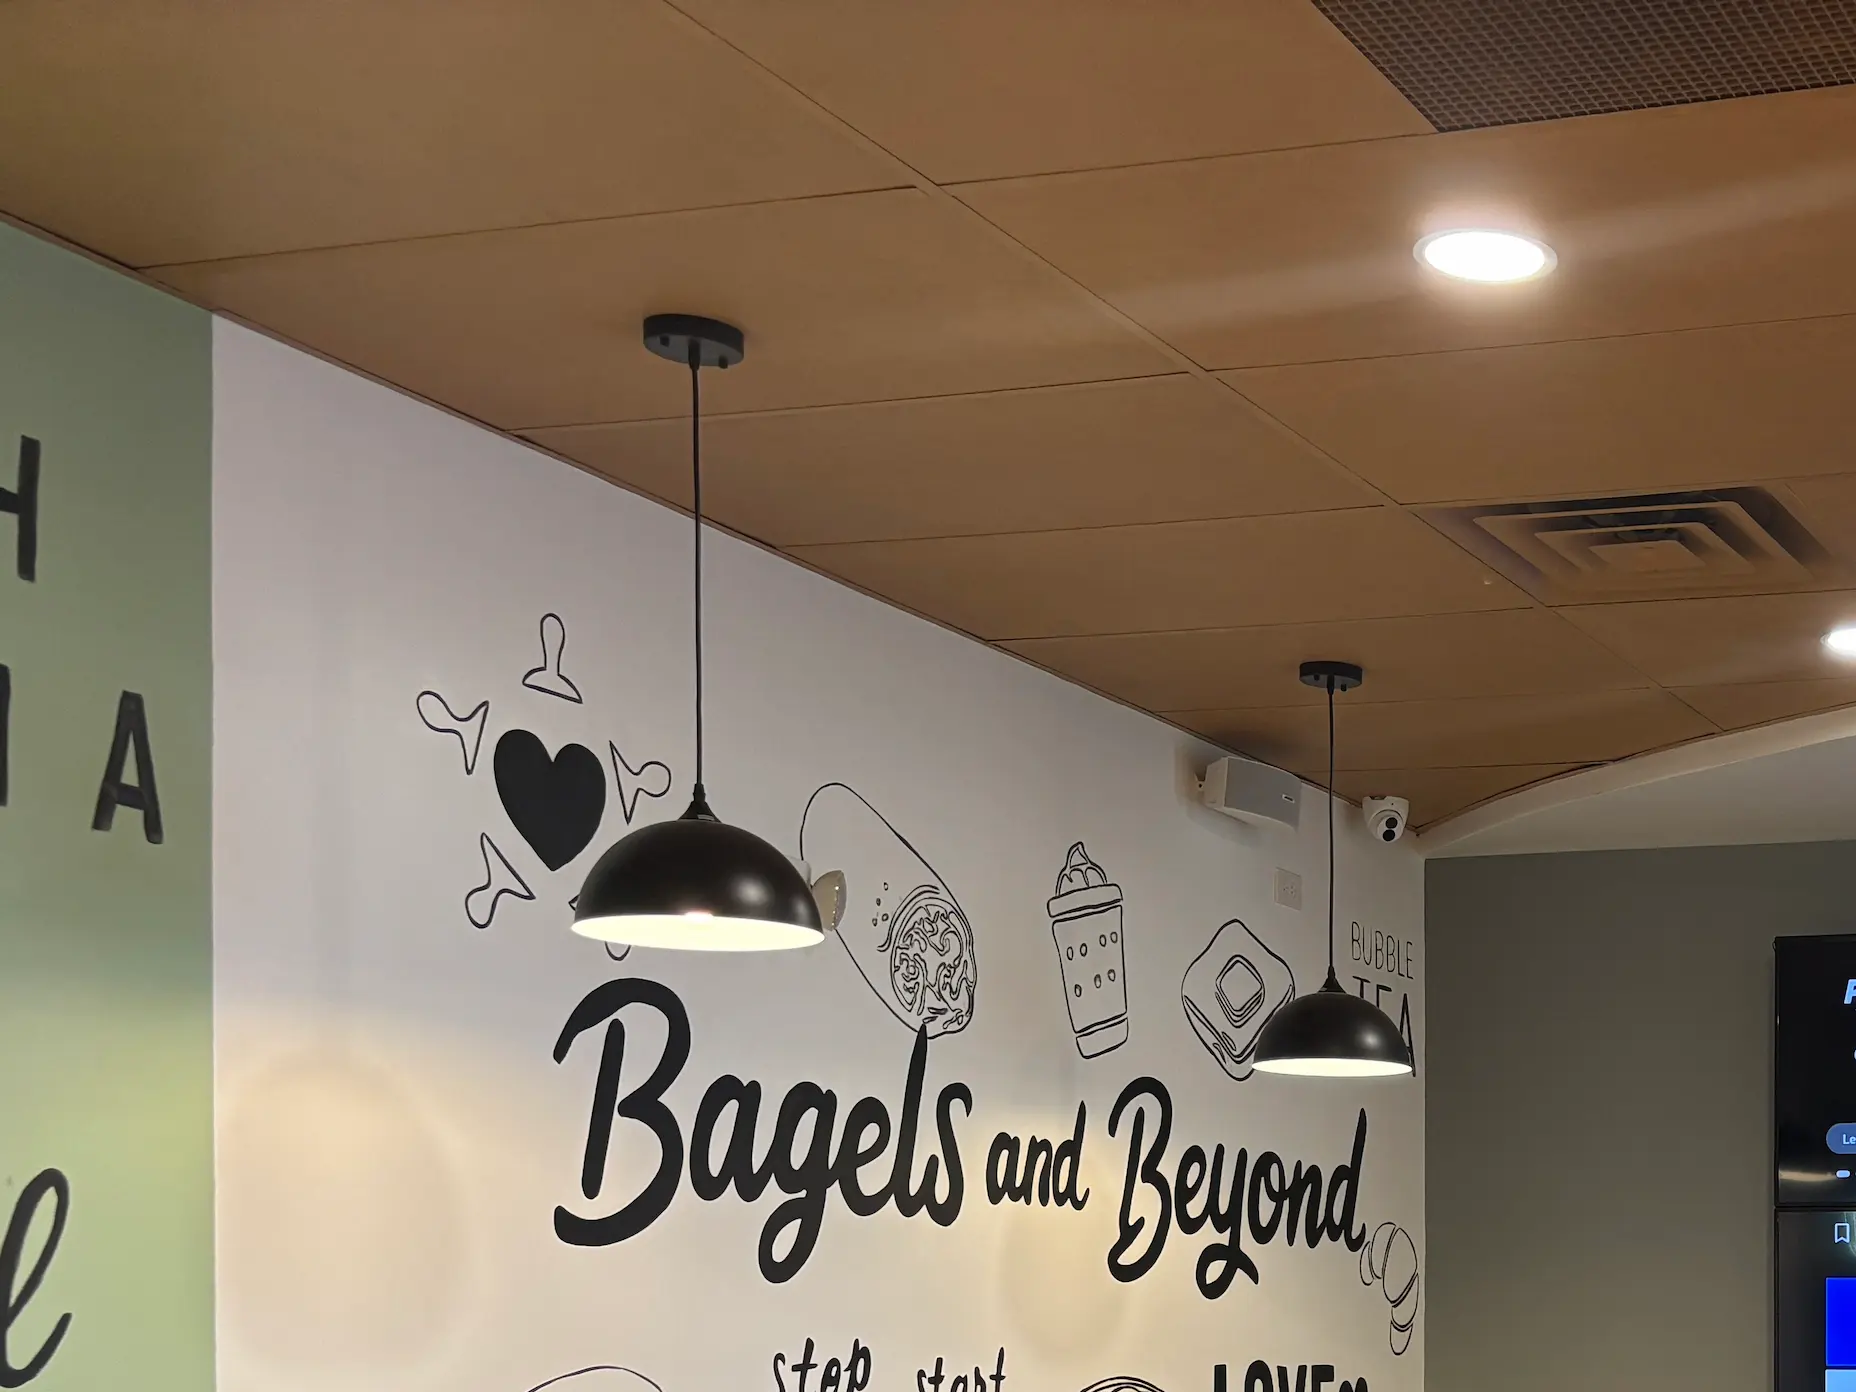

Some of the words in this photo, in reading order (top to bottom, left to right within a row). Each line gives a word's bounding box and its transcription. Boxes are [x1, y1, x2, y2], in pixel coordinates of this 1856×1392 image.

[1351, 921, 1414, 980] BUBBLE
[553, 976, 973, 1285] Bagels
[986, 1099, 1091, 1213] and
[1107, 1076, 1367, 1300] Beyond
